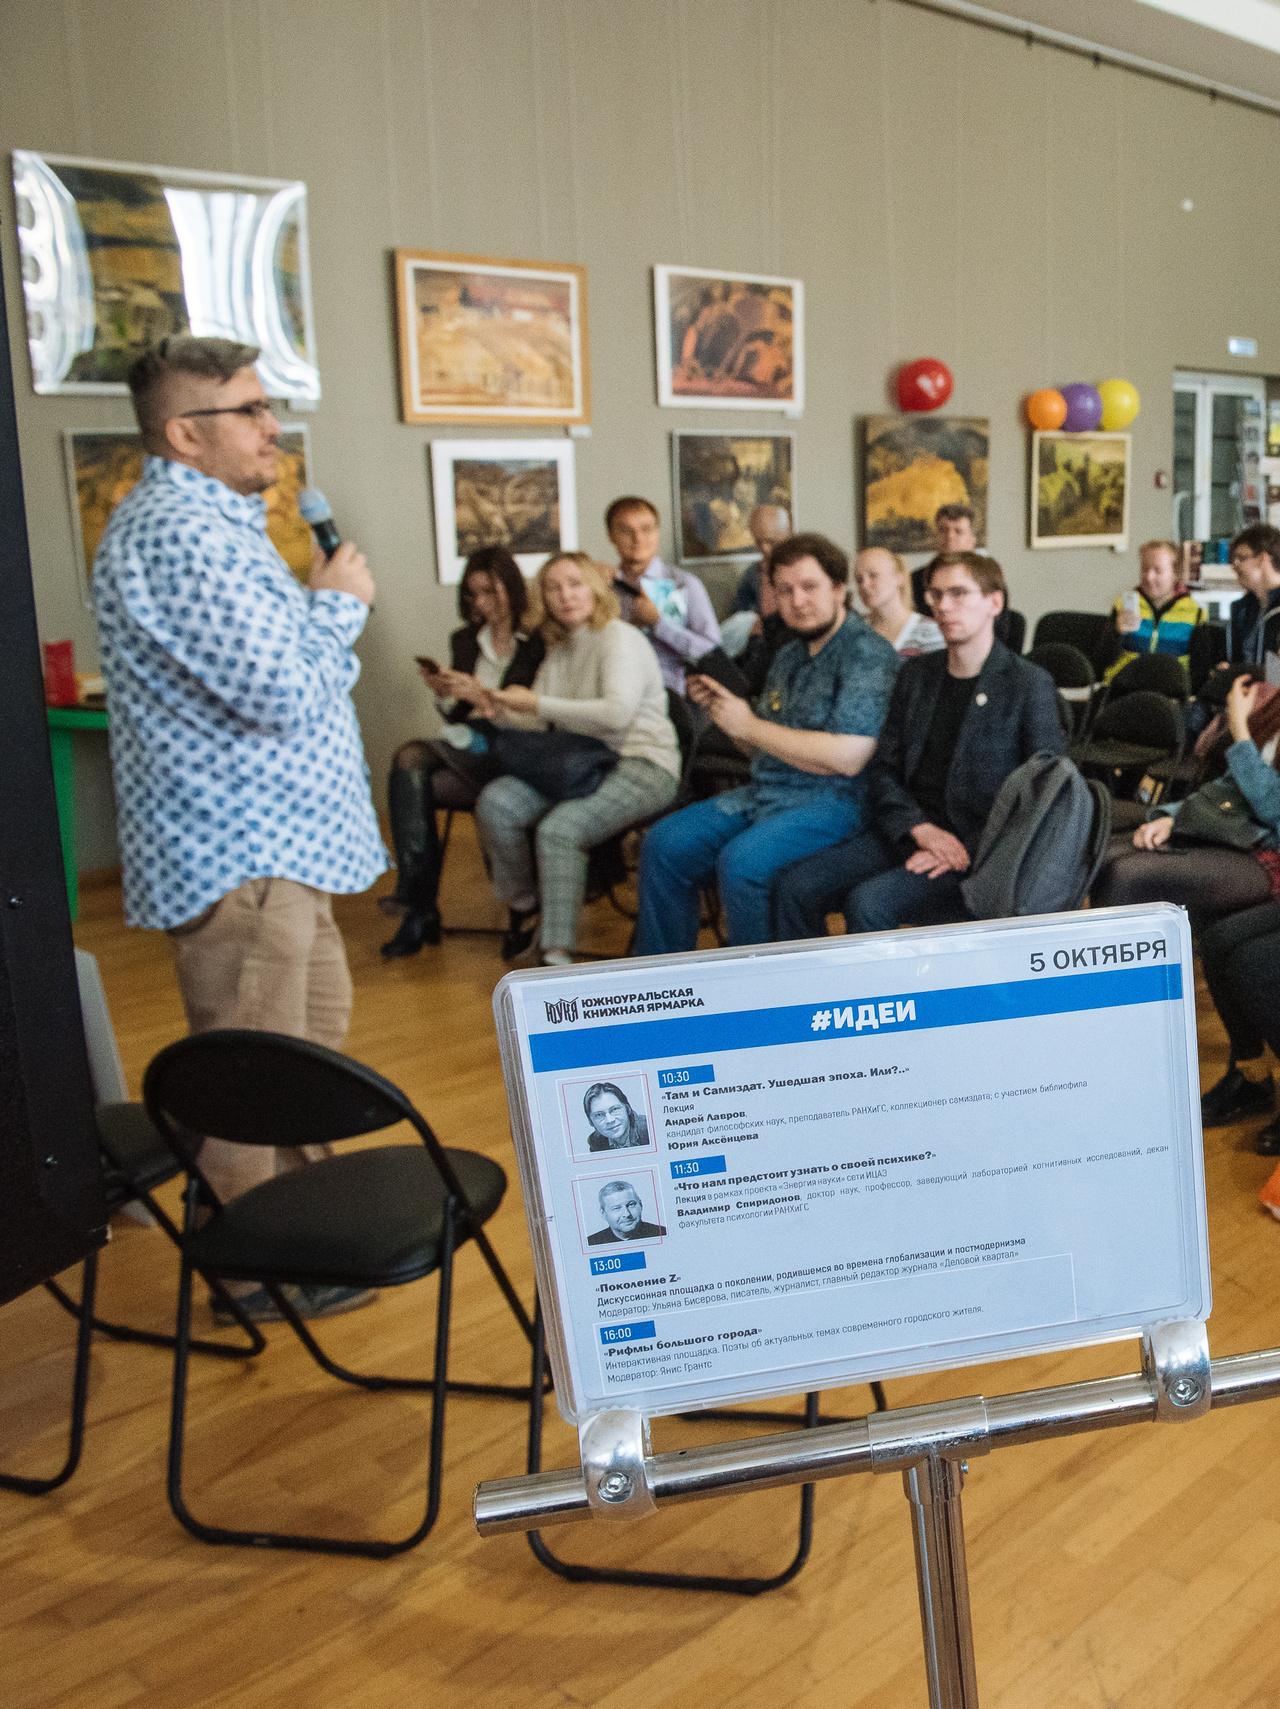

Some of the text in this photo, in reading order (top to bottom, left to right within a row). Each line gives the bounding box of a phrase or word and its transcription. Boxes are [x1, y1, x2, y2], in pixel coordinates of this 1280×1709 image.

[1030, 939, 1167, 973] 5 ОКТЯБРЯ
[581, 987, 694, 1008] ЮЖНОУРАЛЬСКАЯ
[583, 997, 705, 1019] КНИЖНАЯ ЯРМАРКА
[811, 999, 917, 1032] #ИДЕИ
[661, 1071, 690, 1084] 10:30
[661, 1092, 689, 1100] «Там
[702, 1083, 765, 1095] Самиздат.
[767, 1076, 825, 1088] Ушедшая
[828, 1072, 866, 1081] эпоха.
[662, 1104, 694, 1113] Лекция
[664, 1112, 747, 1126] Андрей Лавров,
[666, 1128, 704, 1138] кандидат
[706, 1121, 764, 1133] философских
[765, 1118, 786, 1126] наук,
[788, 1111, 850, 1123] преподаватель
[851, 1104, 888, 1115] РАНХиГС,
[890, 1099, 947, 1110] коллекционер
[948, 1094, 992, 1104] самиздата;
[1000, 1088, 1037, 1099] участием
[1039, 1081, 1087, 1092] библиофила
[667, 1134, 758, 1150] Юрия Аксёнцева
[674, 1162, 699, 1175] 11:30
[676, 1146, 1168, 1217] Владимир Спиридонов, доктор наук, профессор, заведующий лабораторией когнитивных исследований, декан
[701, 1179, 726, 1188] нам
[728, 1171, 788, 1185] предстоит
[789, 1166, 829, 1178] узнать
[840, 1158, 875, 1169] своей
[877, 1151, 936, 1165] психике?»
[675, 1195, 706, 1204] Лекция
[713, 1190, 743, 1201] рамках
[744, 1185, 777, 1195] проекта
[778, 1180, 816, 1189] «Энергия
[817, 1177, 845, 1185] науки»
[865, 1169, 887, 1179] ИЦАЭ
[678, 1203, 809, 1229] факультета психологии РАНХиГС
[594, 1258, 621, 1272] 13:00
[596, 1291, 667, 1307] Дискуссионная
[669, 1284, 714, 1295] площадка
[724, 1275, 774, 1287] поколении,
[776, 1266, 831, 1281] родившемся
[833, 1263, 844, 1271] во
[846, 1258, 883, 1272] времена
[885, 1250, 945, 1263] глобализации
[954, 1238, 1025, 1253] постмодернизма
[595, 1273, 681, 1292] «Поколение Z»
[598, 1251, 1018, 1318] Модератор: Ульяна Бисерова, писатель, журналист, главный редактор журнала «Деловой квартал»
[603, 1329, 762, 1356] «Рифмы большого города»
[604, 1327, 632, 1341] 16:00
[605, 1306, 983, 1370] Интерактивная площадка. Поэты об актуальных темах современного городского жителя.
[607, 1361, 712, 1383] Модератор: Янис Грантс
